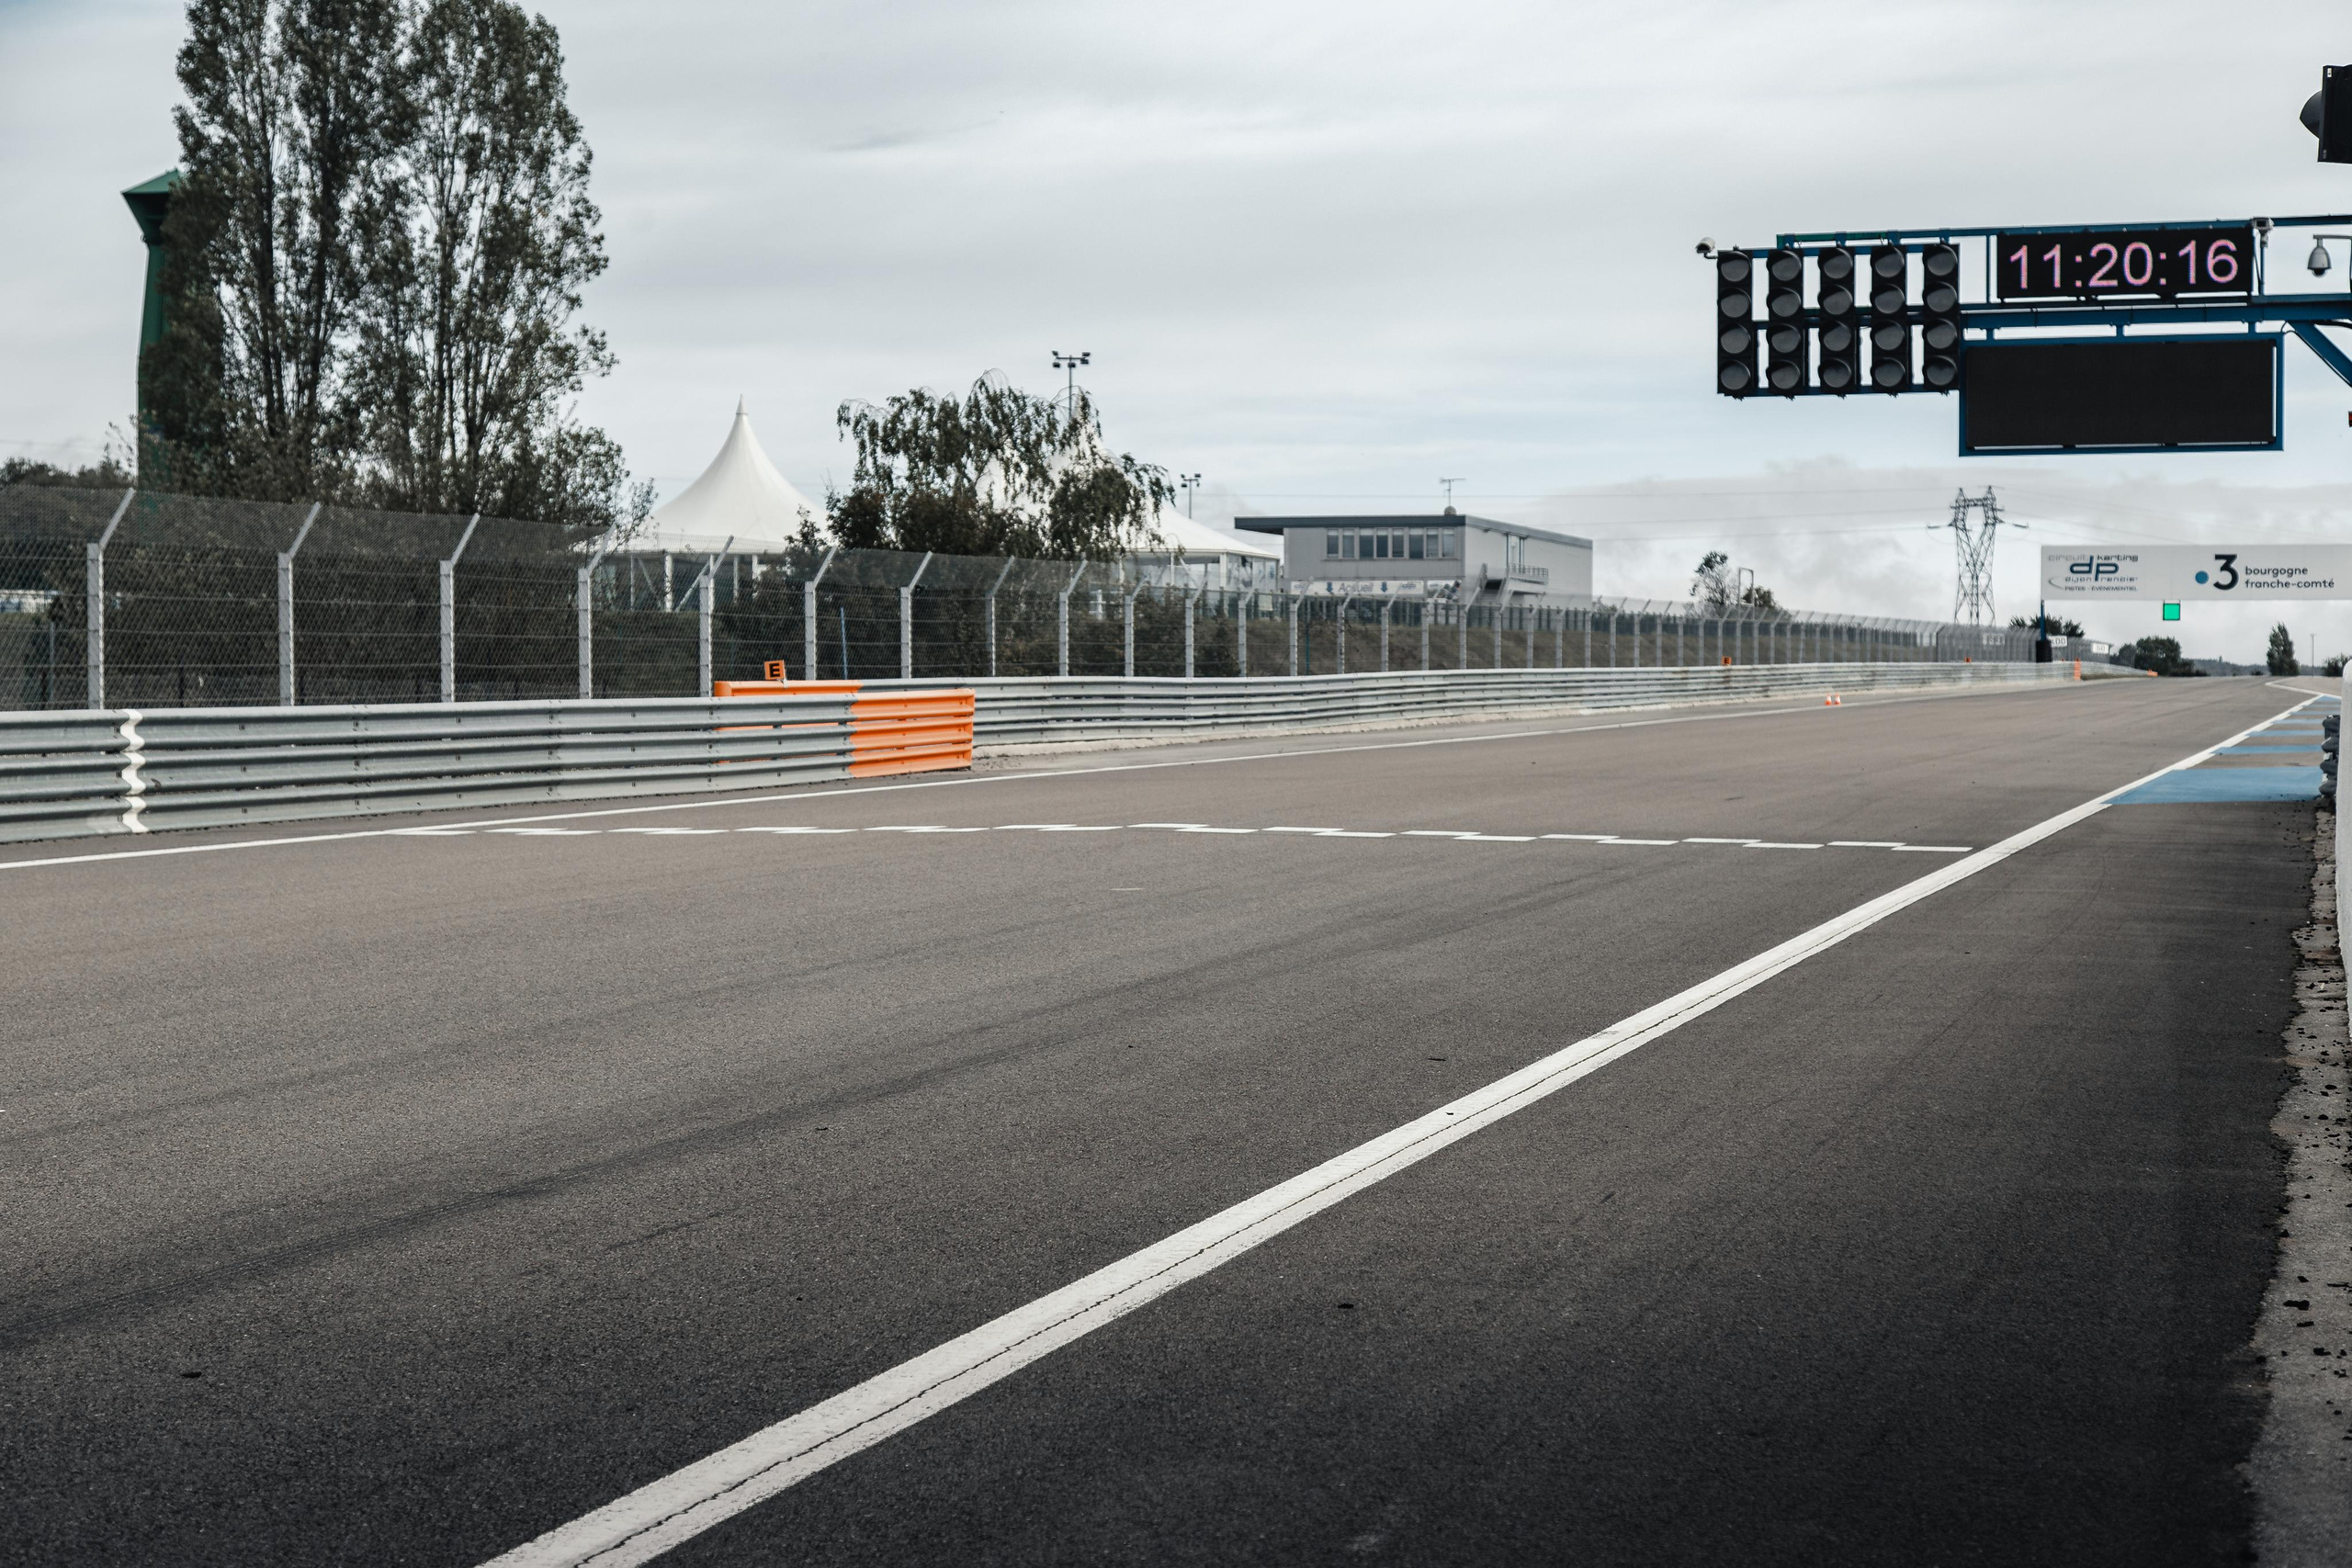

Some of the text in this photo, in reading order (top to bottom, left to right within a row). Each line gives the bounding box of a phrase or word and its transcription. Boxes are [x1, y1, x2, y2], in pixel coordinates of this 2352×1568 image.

[2010, 239, 2238, 289] 11:20:16
[2097, 554, 2139, 562] karting
[2212, 553, 2240, 591] 3
[2245, 566, 2309, 578] bourgogne
[2245, 578, 2335, 589] franche-comté
[768, 662, 781, 678] E
